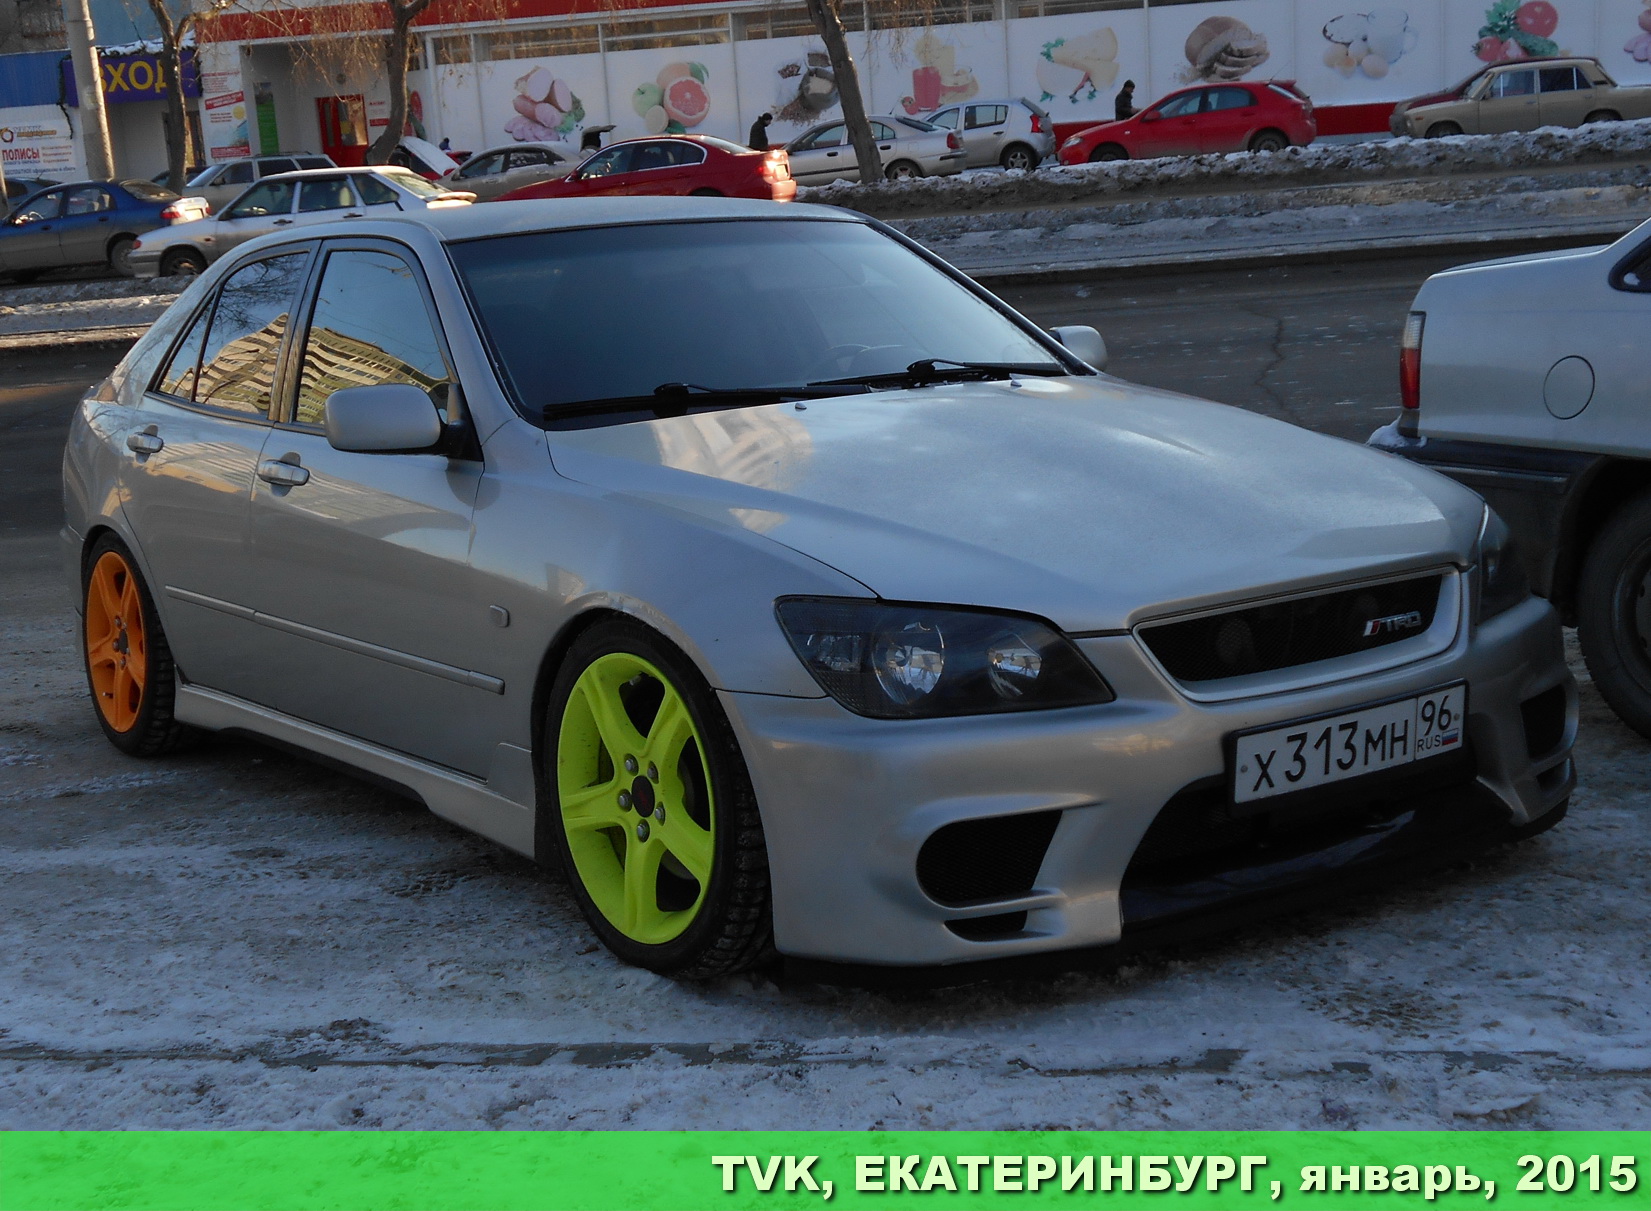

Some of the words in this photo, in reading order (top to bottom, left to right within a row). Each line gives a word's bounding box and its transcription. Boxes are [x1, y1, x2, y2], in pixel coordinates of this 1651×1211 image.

[2, 147, 40, 161] ПОЛИСЫ
[1374, 611, 1421, 633] TRD
[1421, 695, 1452, 736] 96
[1417, 735, 1441, 753] RUS
